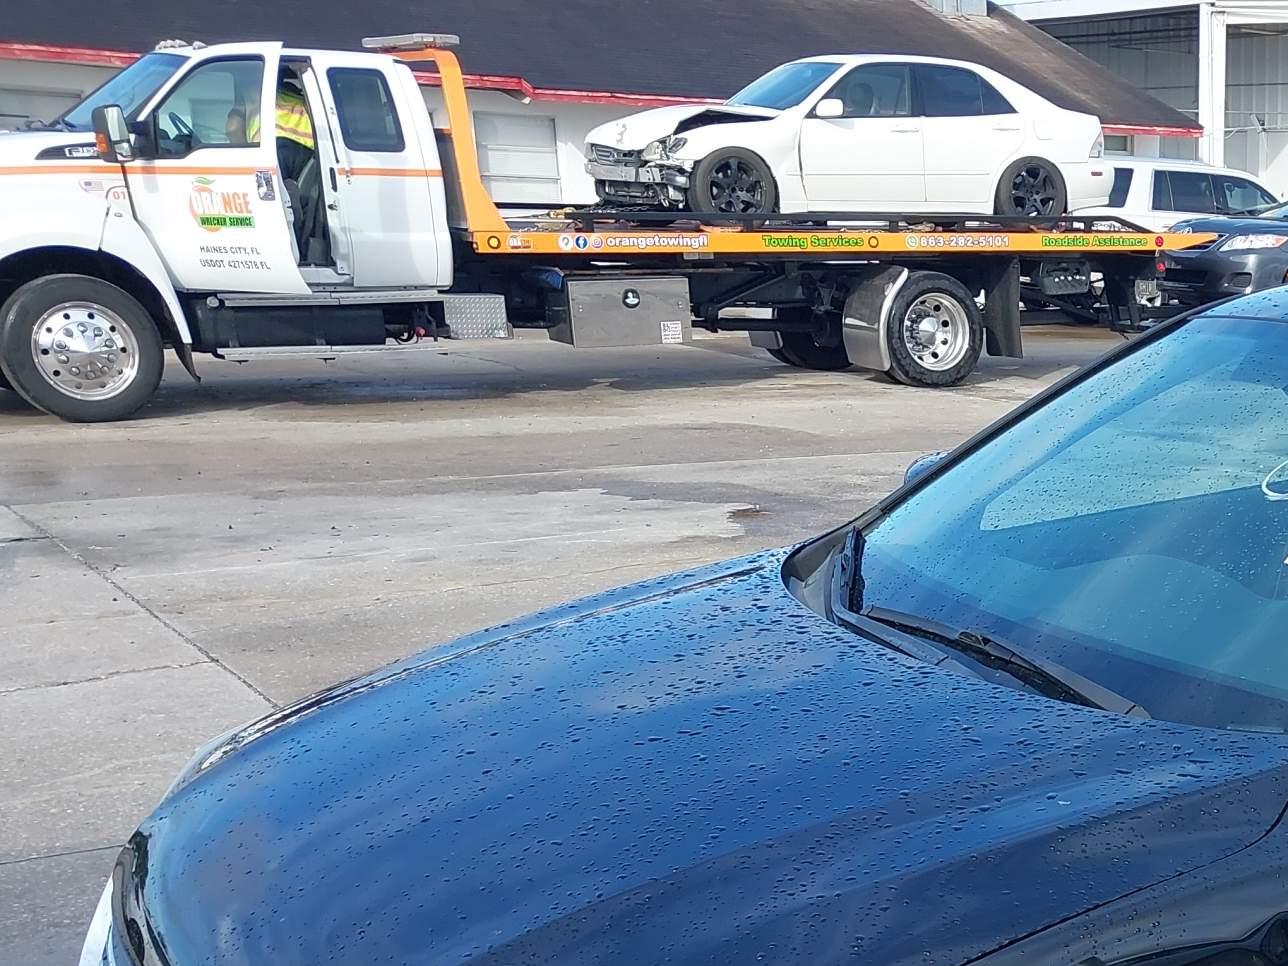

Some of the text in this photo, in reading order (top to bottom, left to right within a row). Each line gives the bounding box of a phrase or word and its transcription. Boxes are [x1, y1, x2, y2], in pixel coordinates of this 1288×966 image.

[200, 216, 253, 227] WRECKER SERVICE
[607, 234, 708, 249] orangetowingfl
[762, 235, 864, 249] Towing Services
[920, 236, 1009, 247] 863-282-5101
[1042, 236, 1148, 247] Roadside Assistance
[200, 245, 228, 254] HAINES
[251, 247, 261, 255] FL
[200, 259, 226, 268] USDOT
